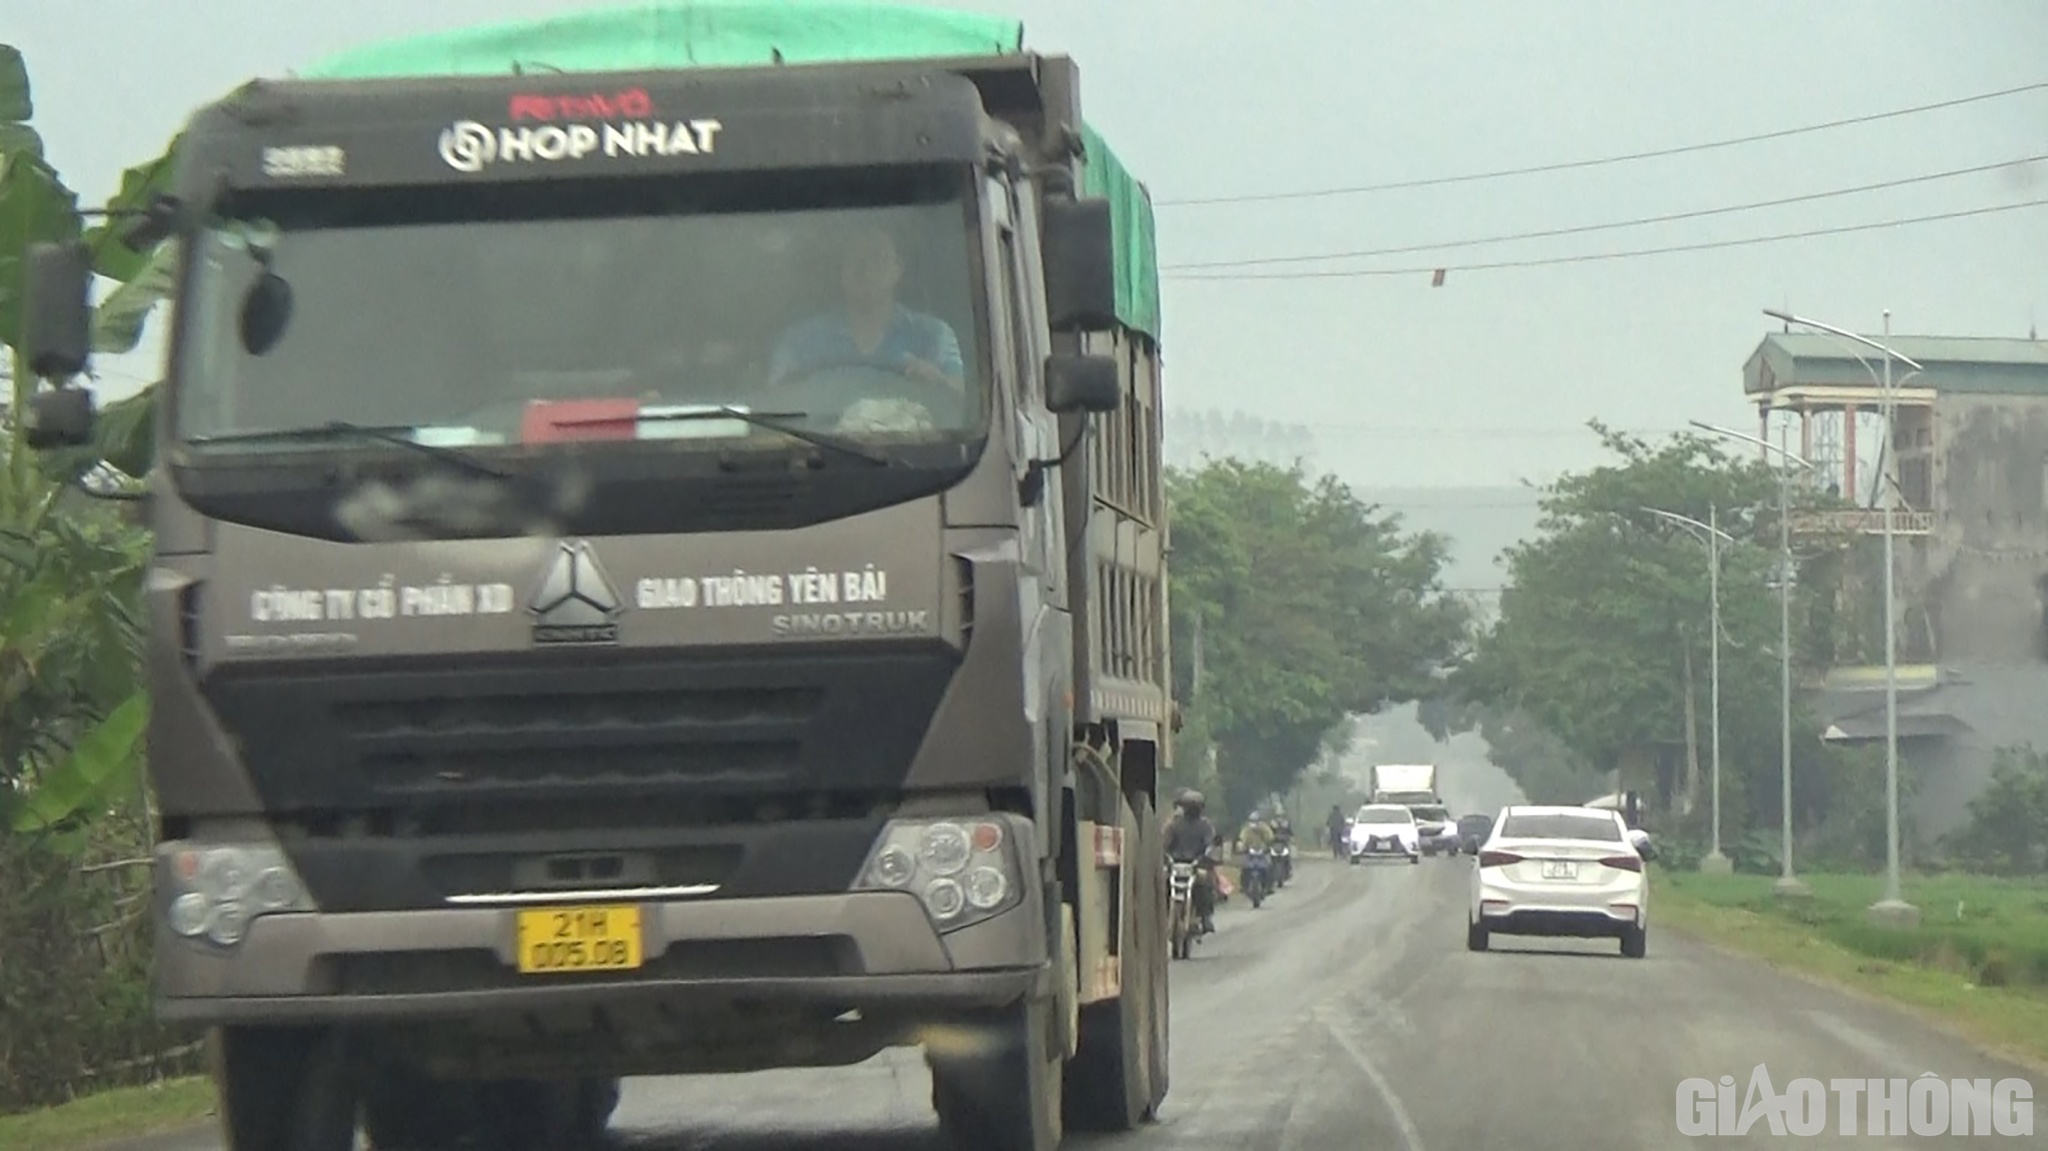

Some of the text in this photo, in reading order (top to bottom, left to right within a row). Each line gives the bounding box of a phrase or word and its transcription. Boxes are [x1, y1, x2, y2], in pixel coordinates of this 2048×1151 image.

[637, 578, 697, 608] GIAO
[702, 568, 783, 607] THÔNG
[788, 566, 839, 603] YÊN
[772, 609, 928, 636] SINOTRUK
